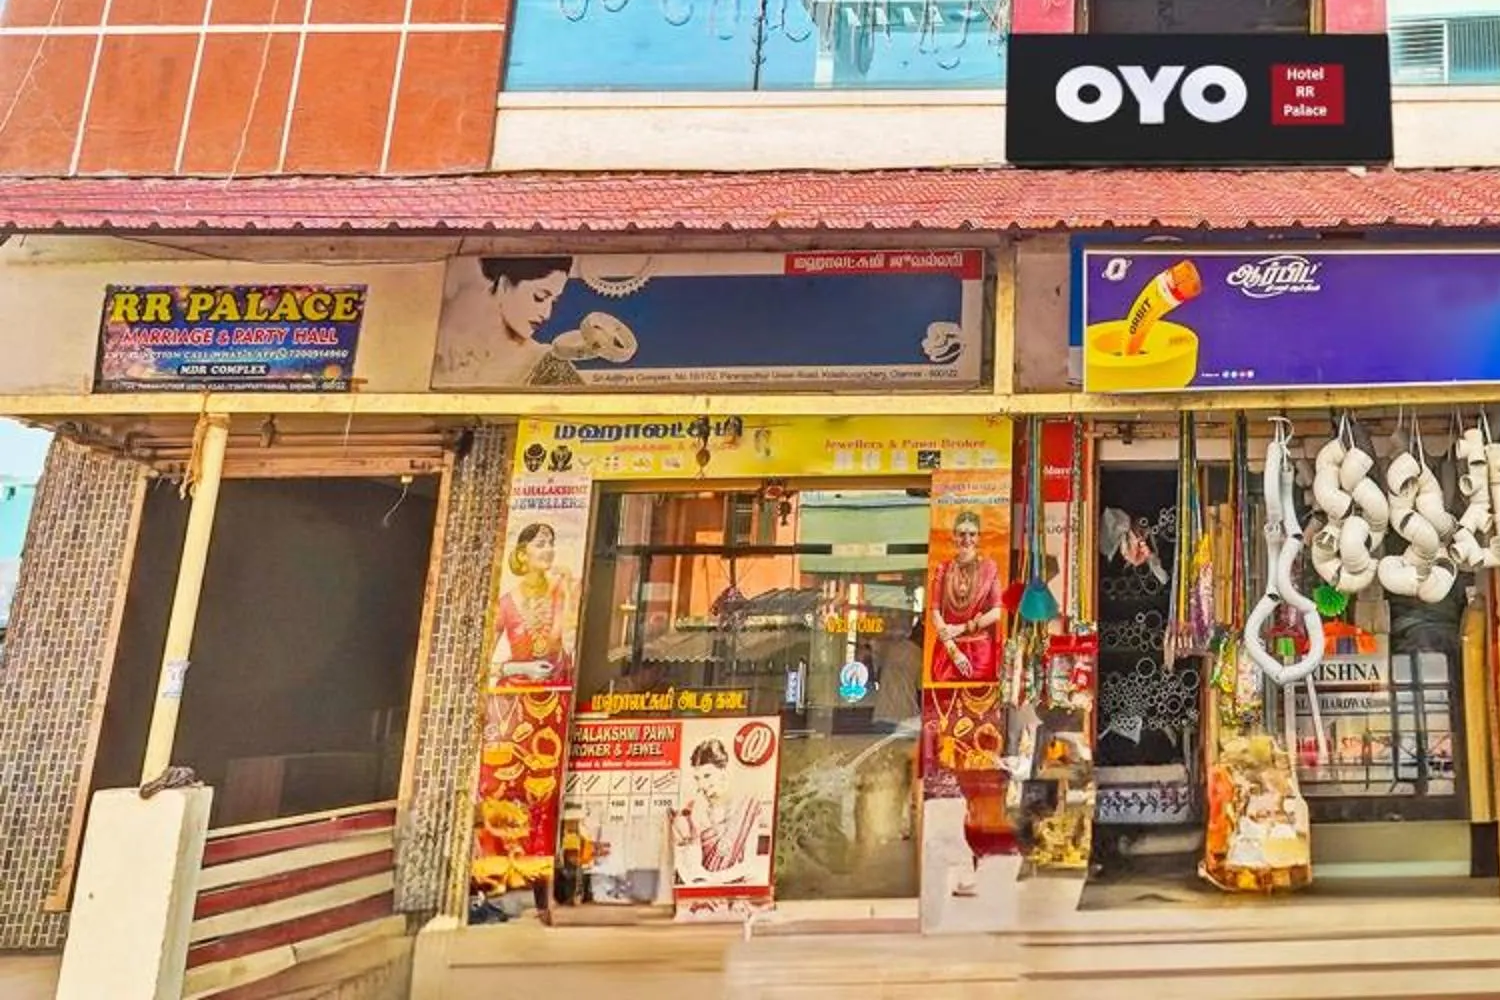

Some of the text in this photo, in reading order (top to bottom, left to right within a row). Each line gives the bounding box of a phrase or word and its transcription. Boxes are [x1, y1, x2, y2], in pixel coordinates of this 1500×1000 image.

[1286, 67, 1325, 81] Hotel
[1055, 65, 1248, 125] OYO
[1295, 86, 1316, 98] RR
[1283, 104, 1328, 117] Palace
[109, 291, 362, 324] RR PALACE
[1129, 298, 1152, 336] ORBIT
[121, 327, 339, 346] MARRIAGE & PARTY HALL
[180, 364, 267, 376] MDR COMPLEX
[824, 439, 987, 451] Jewellers & Pawn Broker
[1312, 663, 1381, 681] ISHNA
[574, 726, 675, 743] HALAKSHMI PAWN
[613, 743, 622, 757] &
[626, 743, 664, 757] JEWEL
